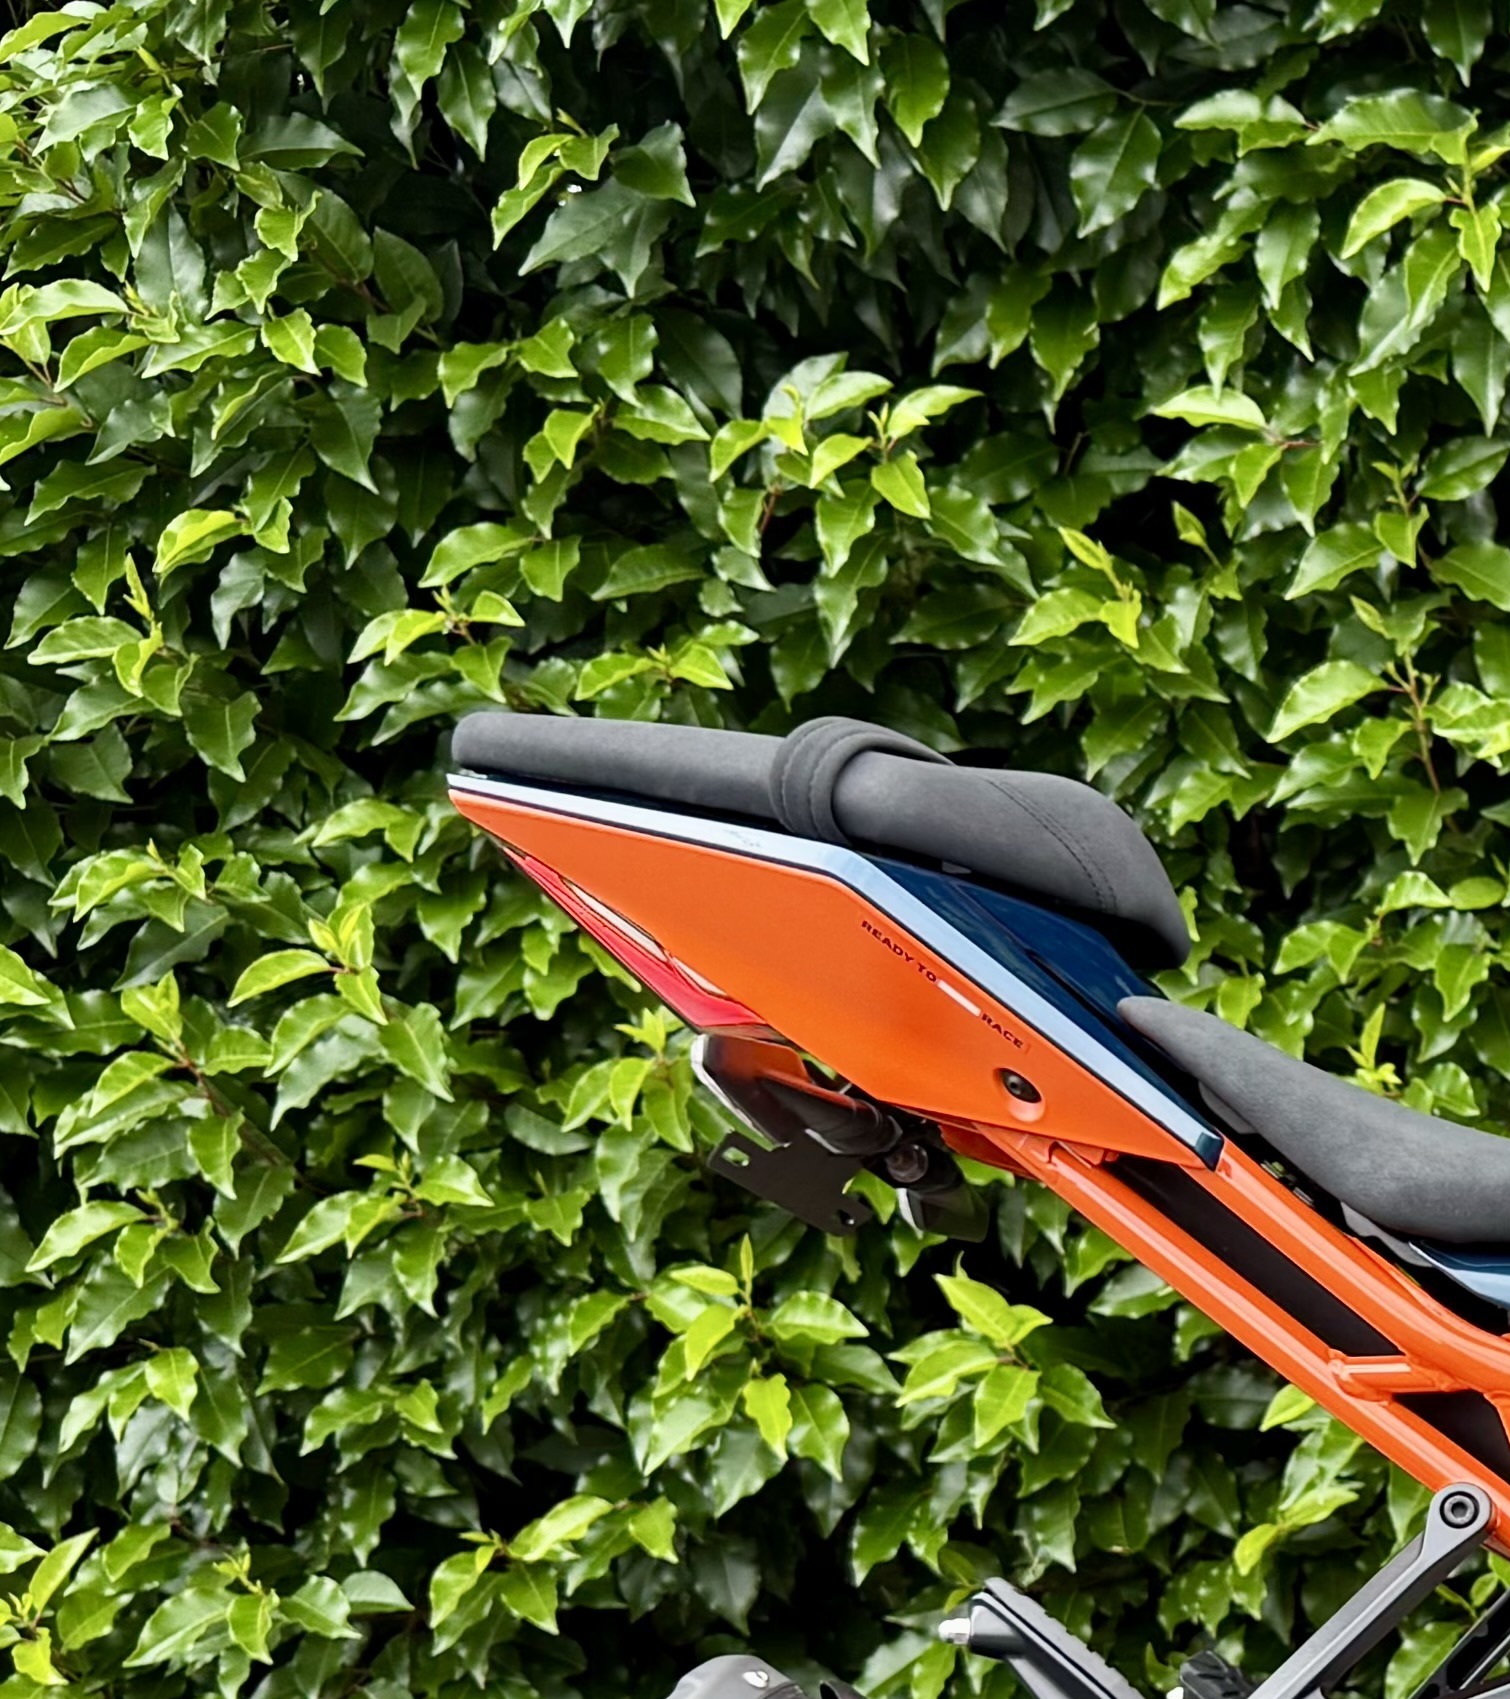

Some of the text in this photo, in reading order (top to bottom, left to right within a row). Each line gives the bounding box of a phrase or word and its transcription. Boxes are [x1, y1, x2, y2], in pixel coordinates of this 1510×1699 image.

[861, 920, 1024, 1049] READY TO RACE
